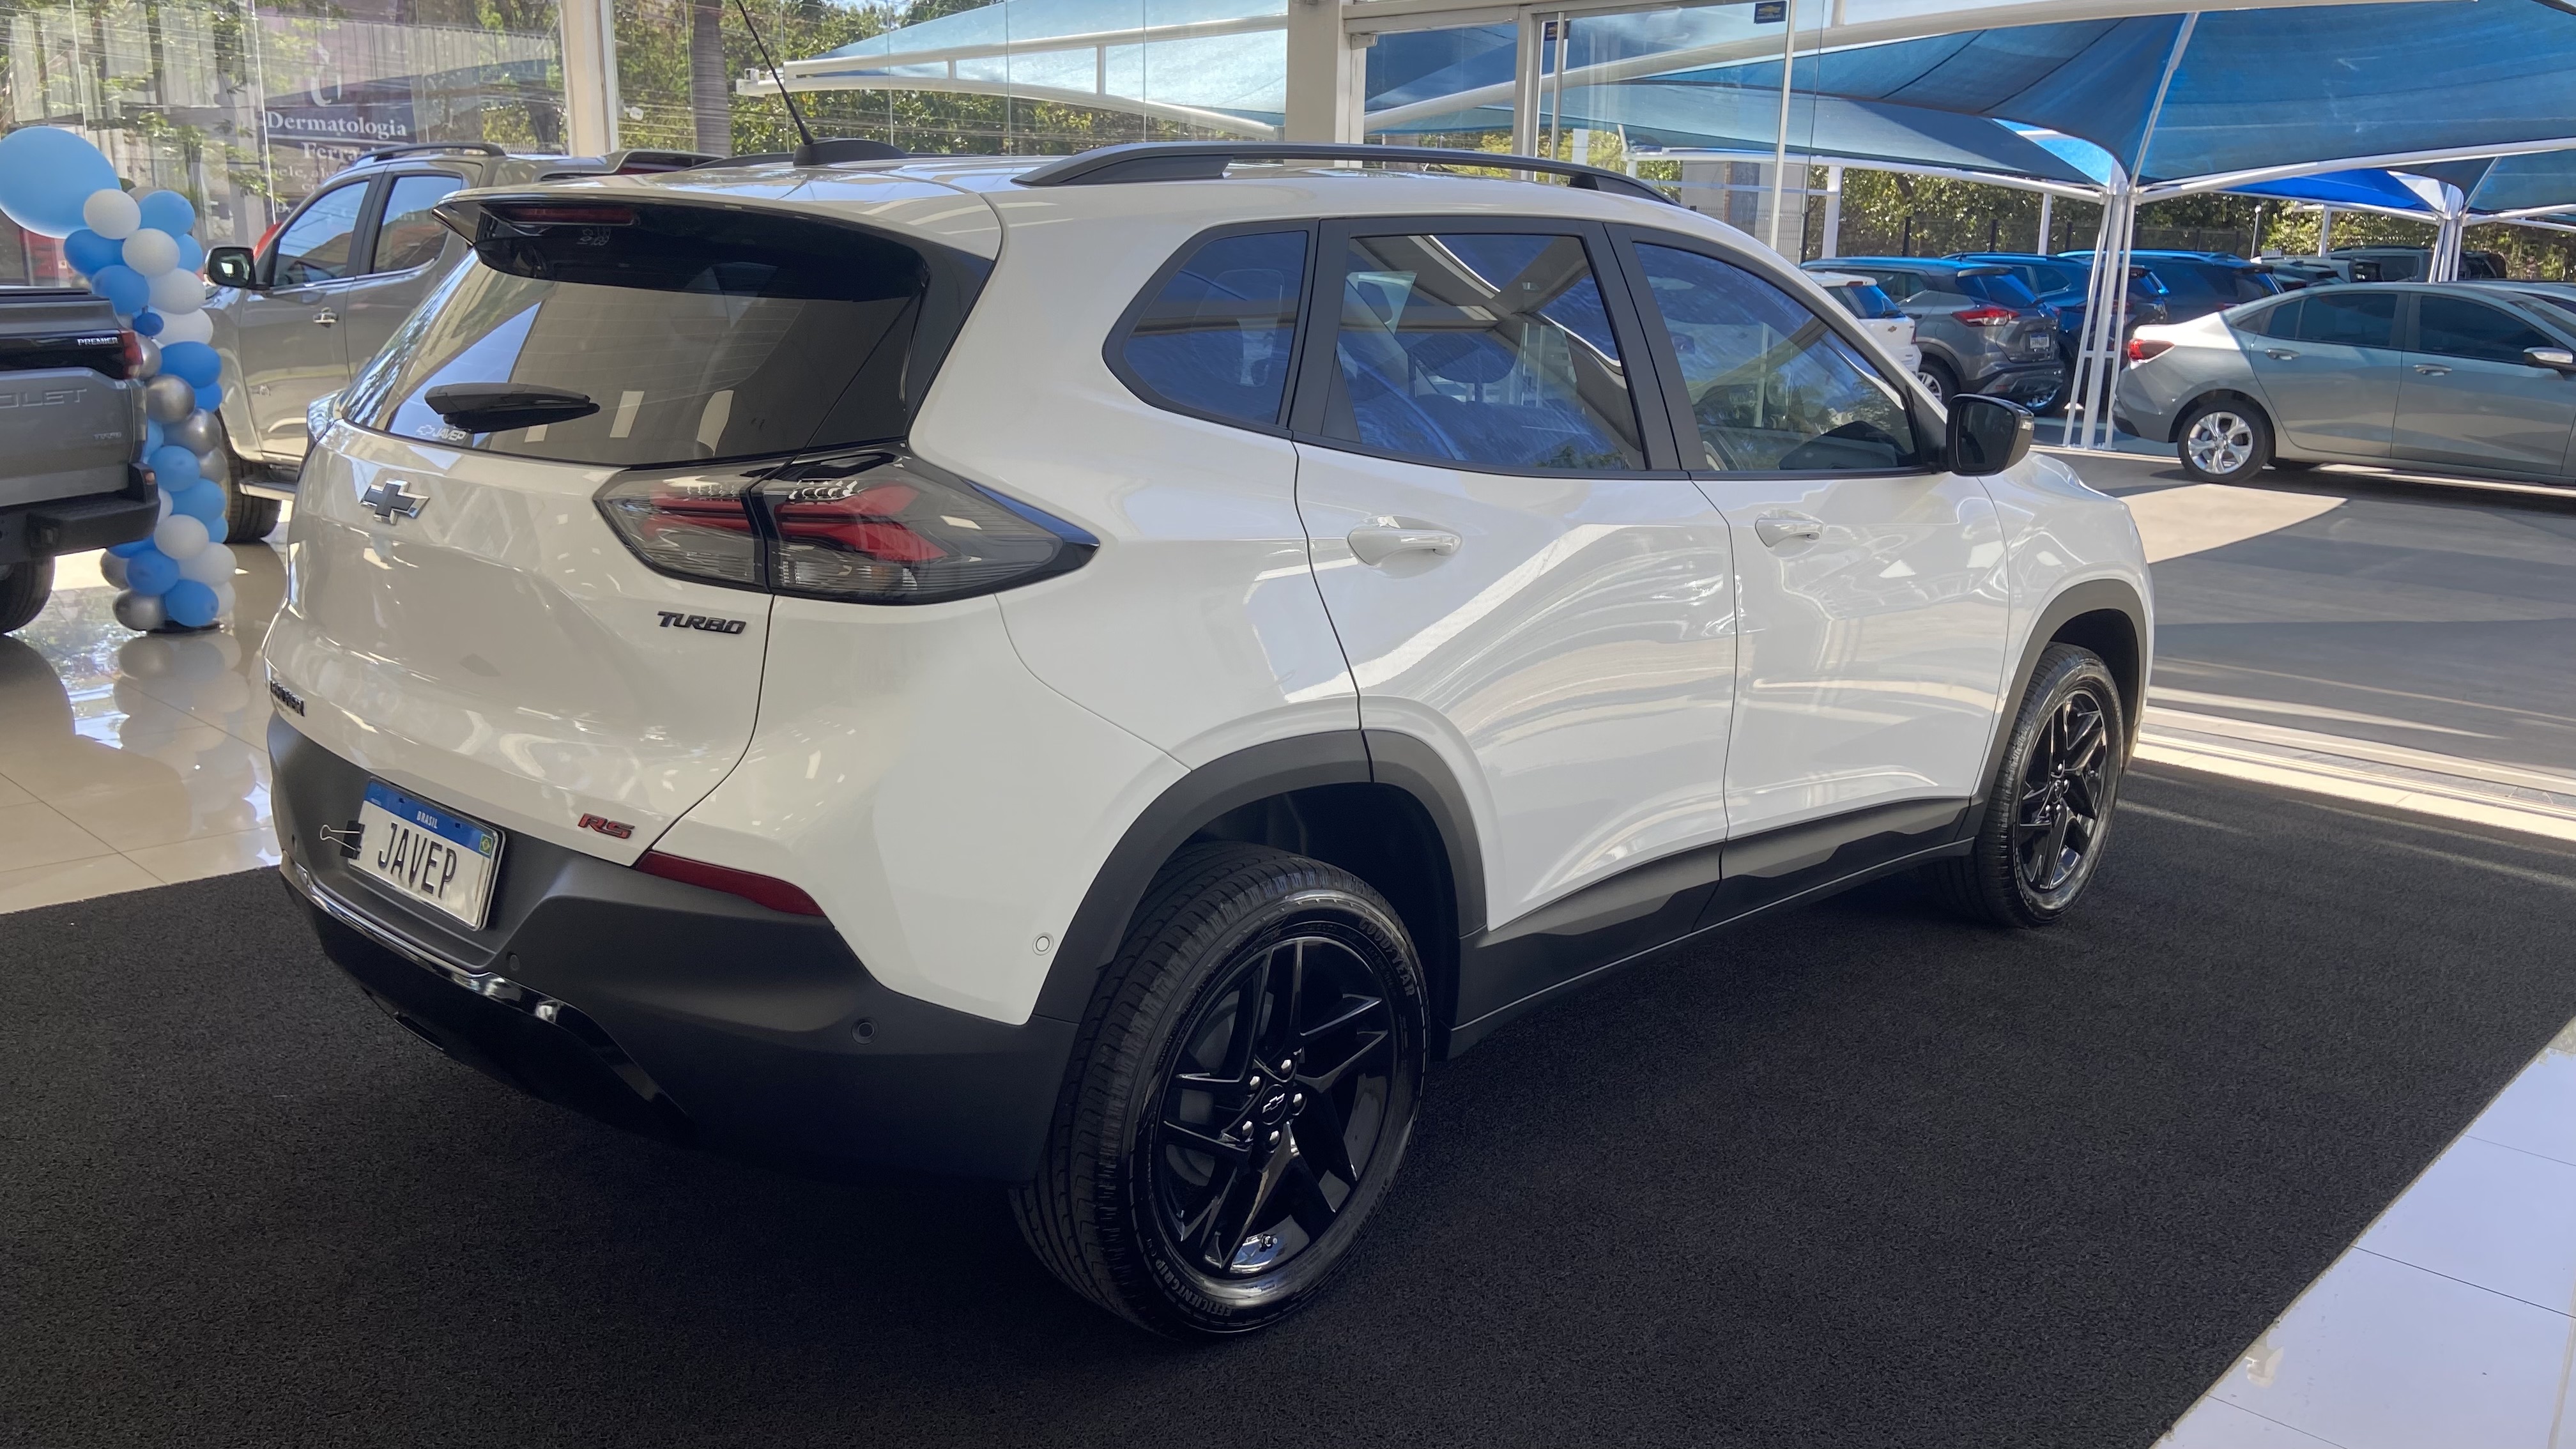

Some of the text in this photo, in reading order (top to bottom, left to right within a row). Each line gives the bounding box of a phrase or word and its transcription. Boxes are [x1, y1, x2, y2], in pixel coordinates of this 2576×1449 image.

[266, 111, 408, 139] Dermatologia
[302, 142, 376, 162] Ferra
[77, 337, 118, 346] PREMIER
[433, 427, 467, 441] JAVEP
[657, 611, 746, 634] TURBO
[416, 810, 438, 829] BRASIL
[578, 812, 636, 839] RS
[377, 822, 457, 900] JAVEP
